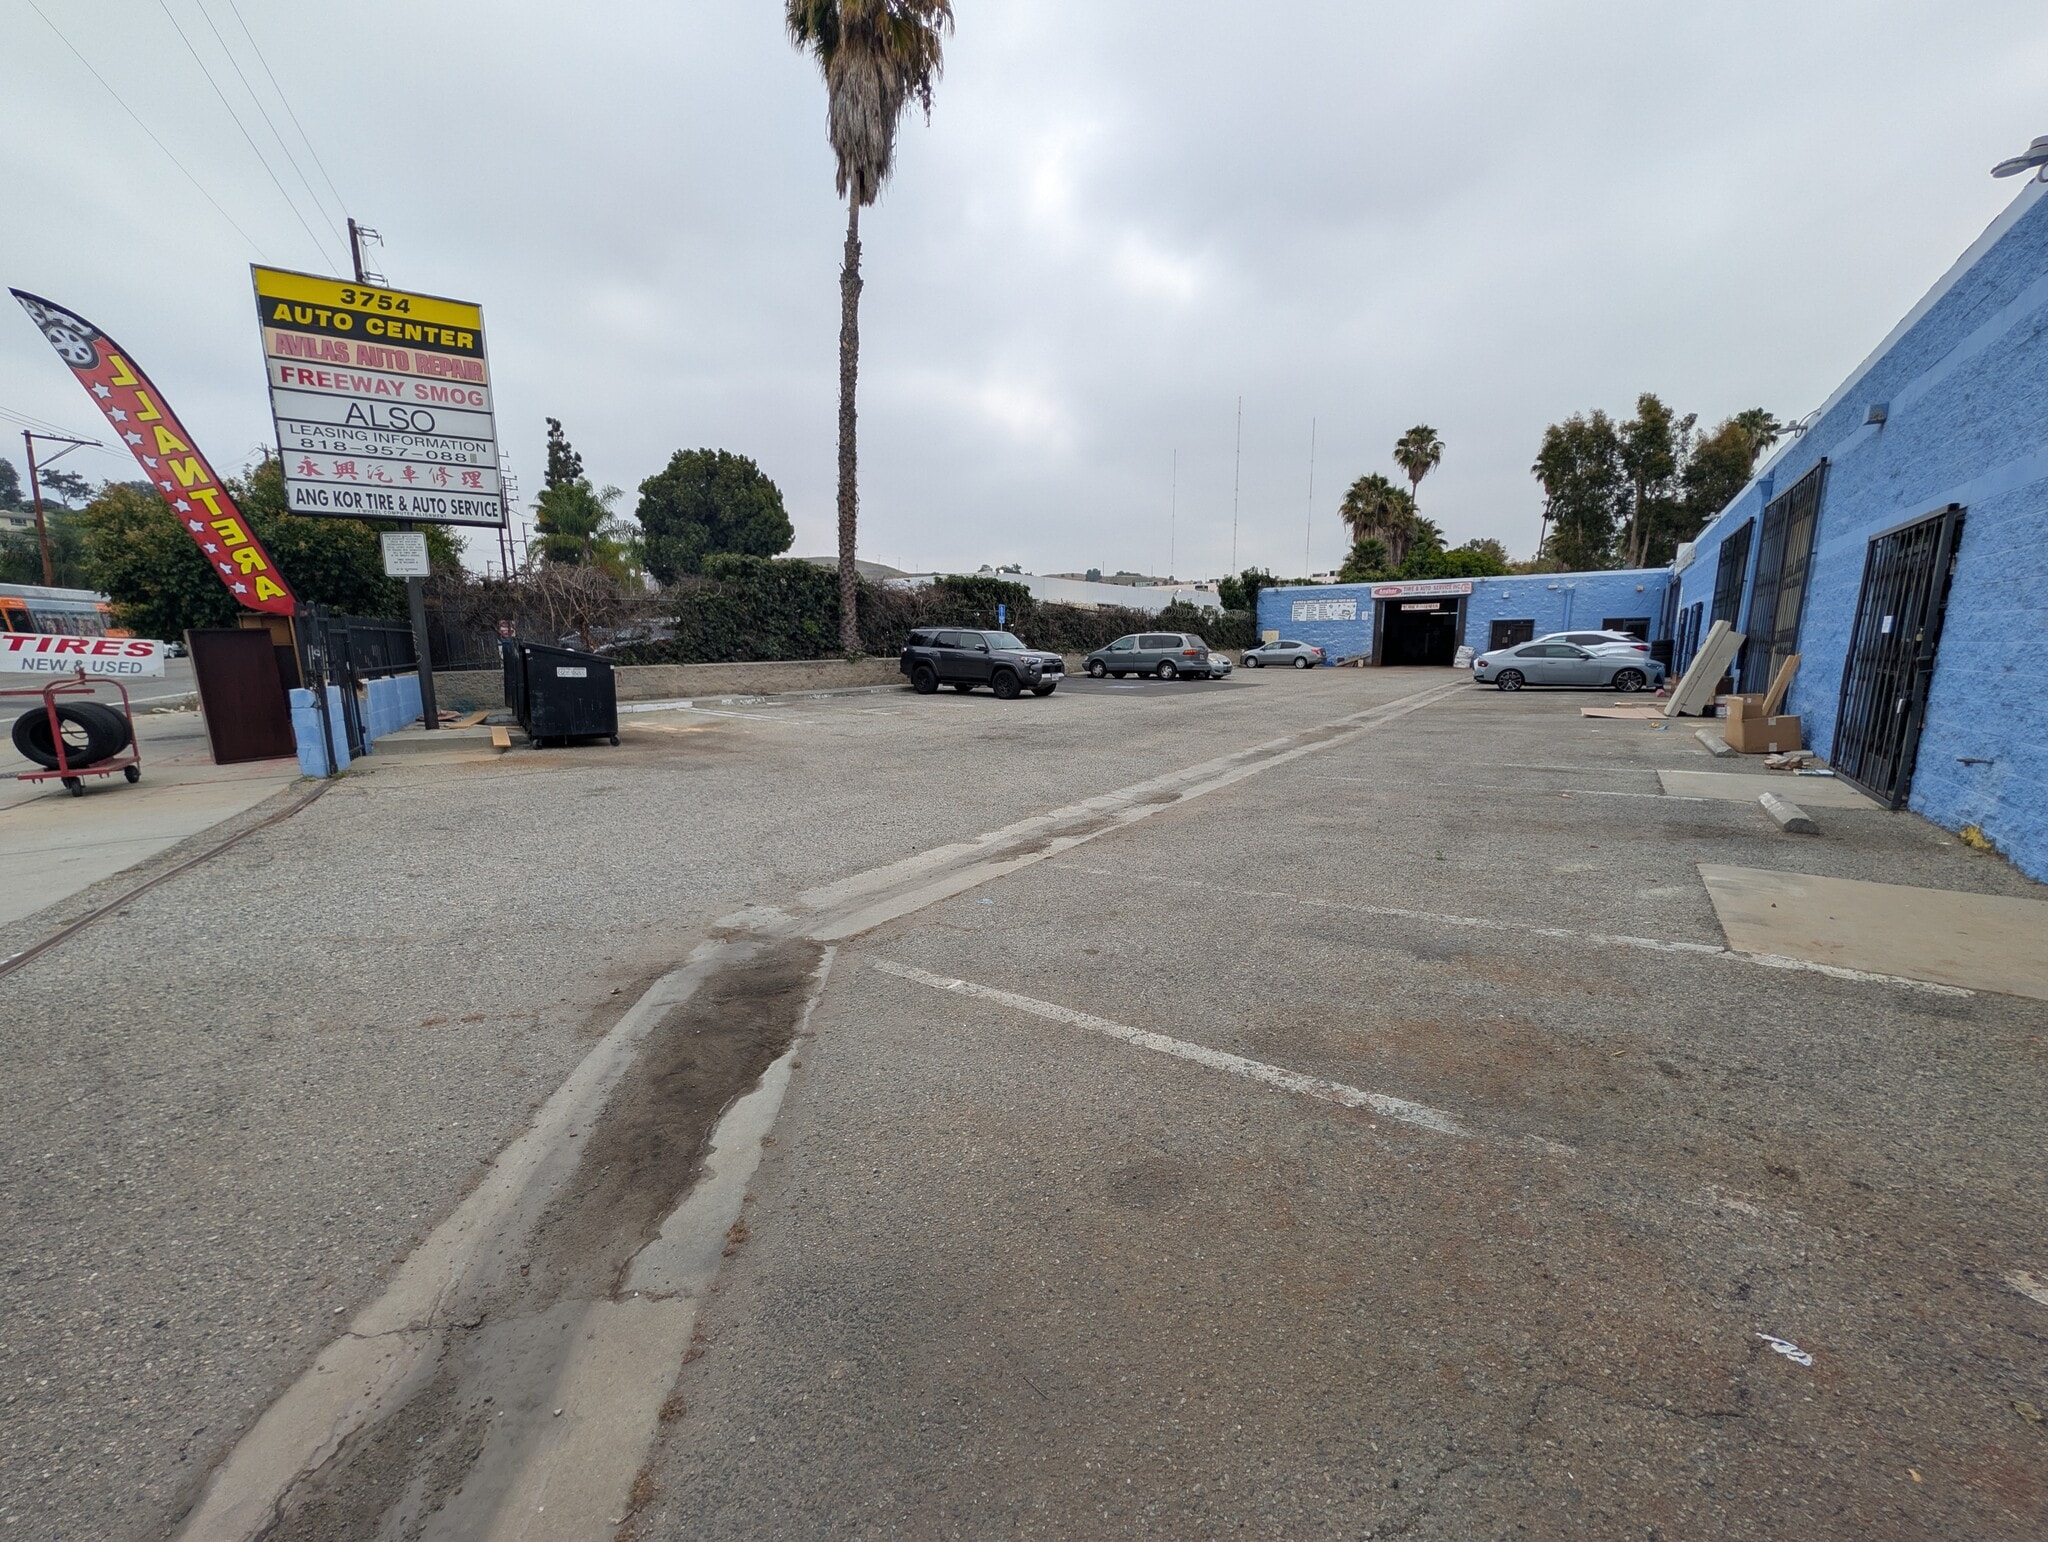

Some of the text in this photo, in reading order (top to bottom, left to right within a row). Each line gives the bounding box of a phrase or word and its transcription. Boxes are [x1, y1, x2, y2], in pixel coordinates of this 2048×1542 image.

[340, 288, 411, 314] 3754
[273, 303, 473, 349] AUTO CENTER
[275, 333, 484, 382] AVILAS AUTO REPAIR
[280, 365, 484, 407] FREEWAY SMOG
[344, 402, 435, 433] ALSO
[289, 423, 487, 453] LEASING INFORMATION
[300, 438, 477, 463] 818-957-088
[297, 455, 484, 489] 永興汽車修理
[296, 487, 499, 518] ANG KOR TIRE & AUTO SERVICE
[2, 635, 155, 657] TIRES
[21, 657, 143, 674] NEW & USED
